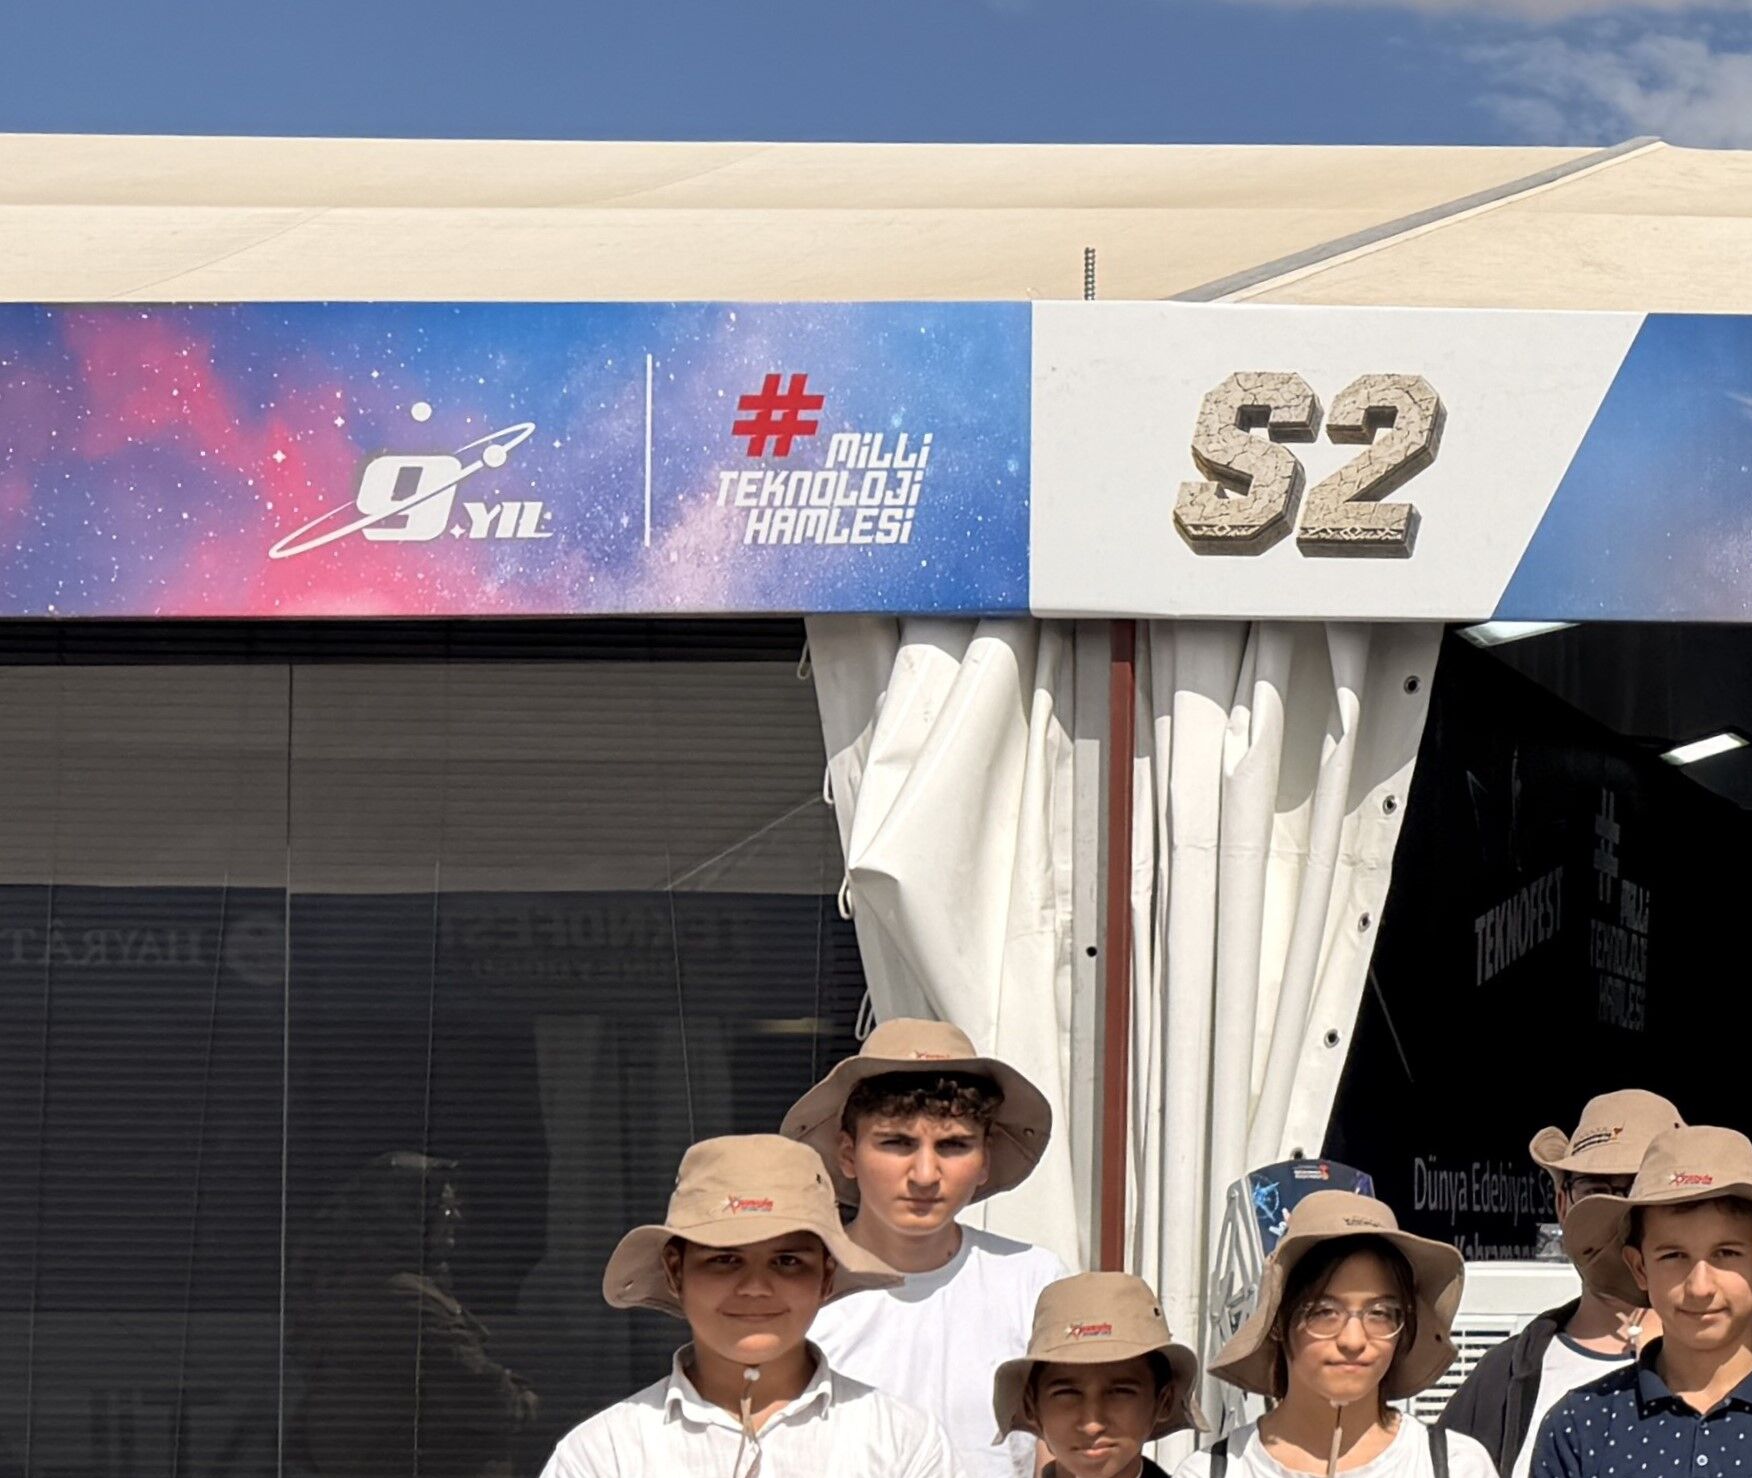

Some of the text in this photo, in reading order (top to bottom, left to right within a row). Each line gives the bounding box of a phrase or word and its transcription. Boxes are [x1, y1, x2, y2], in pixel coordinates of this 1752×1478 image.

[716, 469, 925, 506] TEKNOLOJİ
[1173, 371, 1447, 558] S2
[744, 507, 913, 544] HAMLESİ
[1474, 865, 1564, 987] TEKNOFEST
[1414, 1154, 1468, 1227] Dünya
[1472, 1160, 1536, 1227] Edebiyat
